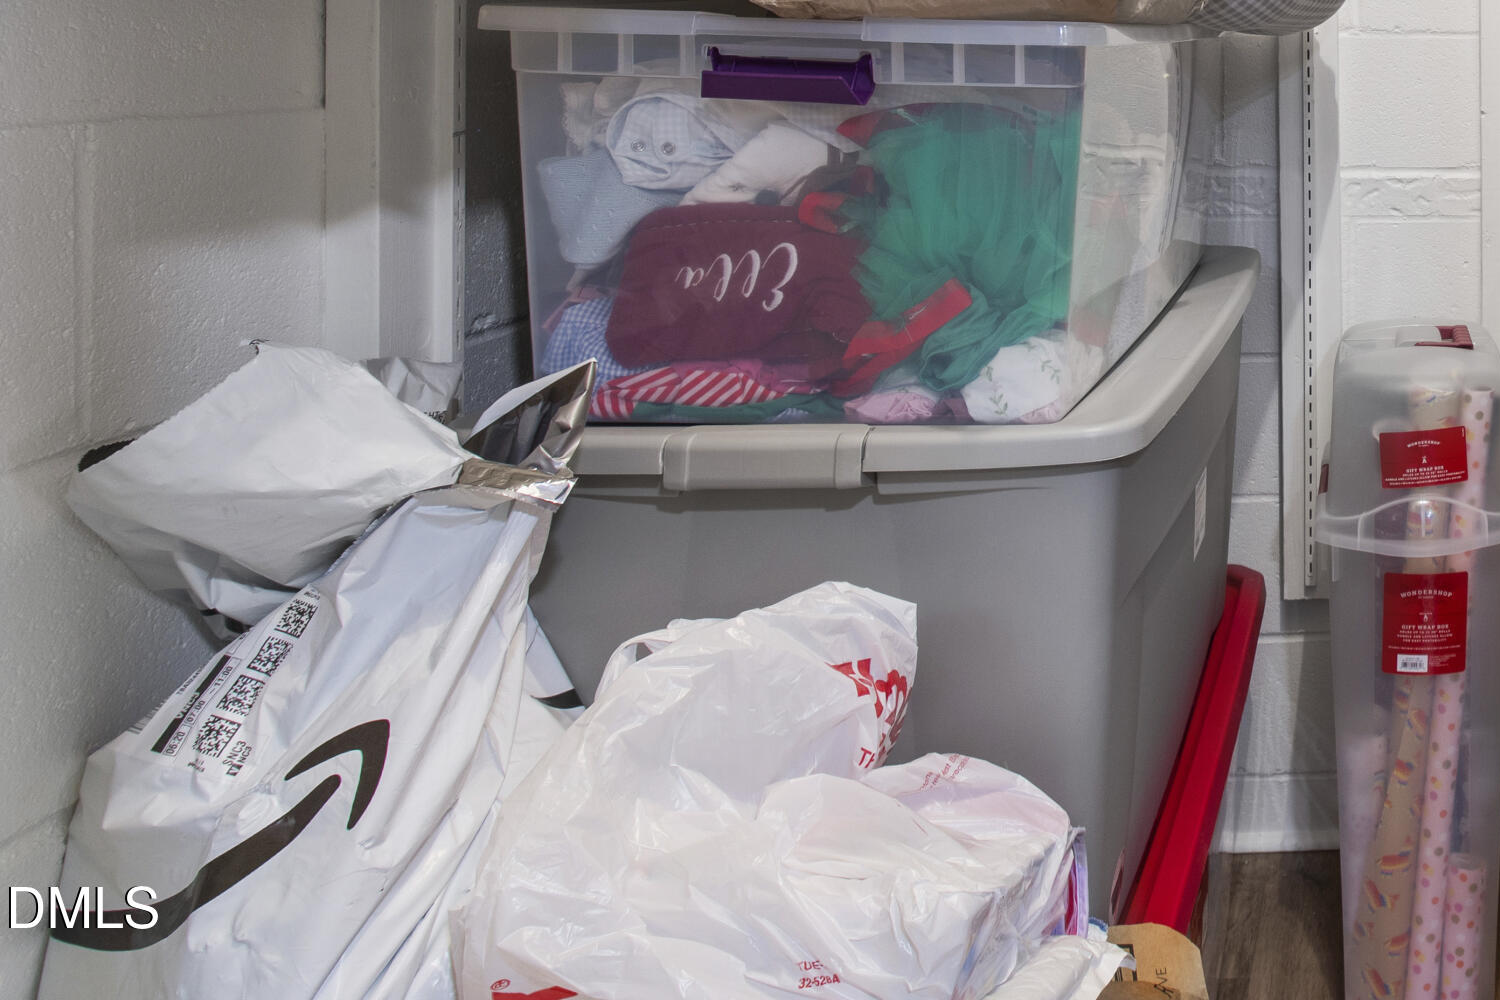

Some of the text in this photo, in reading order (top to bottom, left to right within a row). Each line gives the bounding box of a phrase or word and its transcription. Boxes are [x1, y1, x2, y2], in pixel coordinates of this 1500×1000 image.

[675, 242, 798, 312] Ella
[1400, 589, 1453, 599] WONDERSHOP
[214, 665, 234, 687] 11:00
